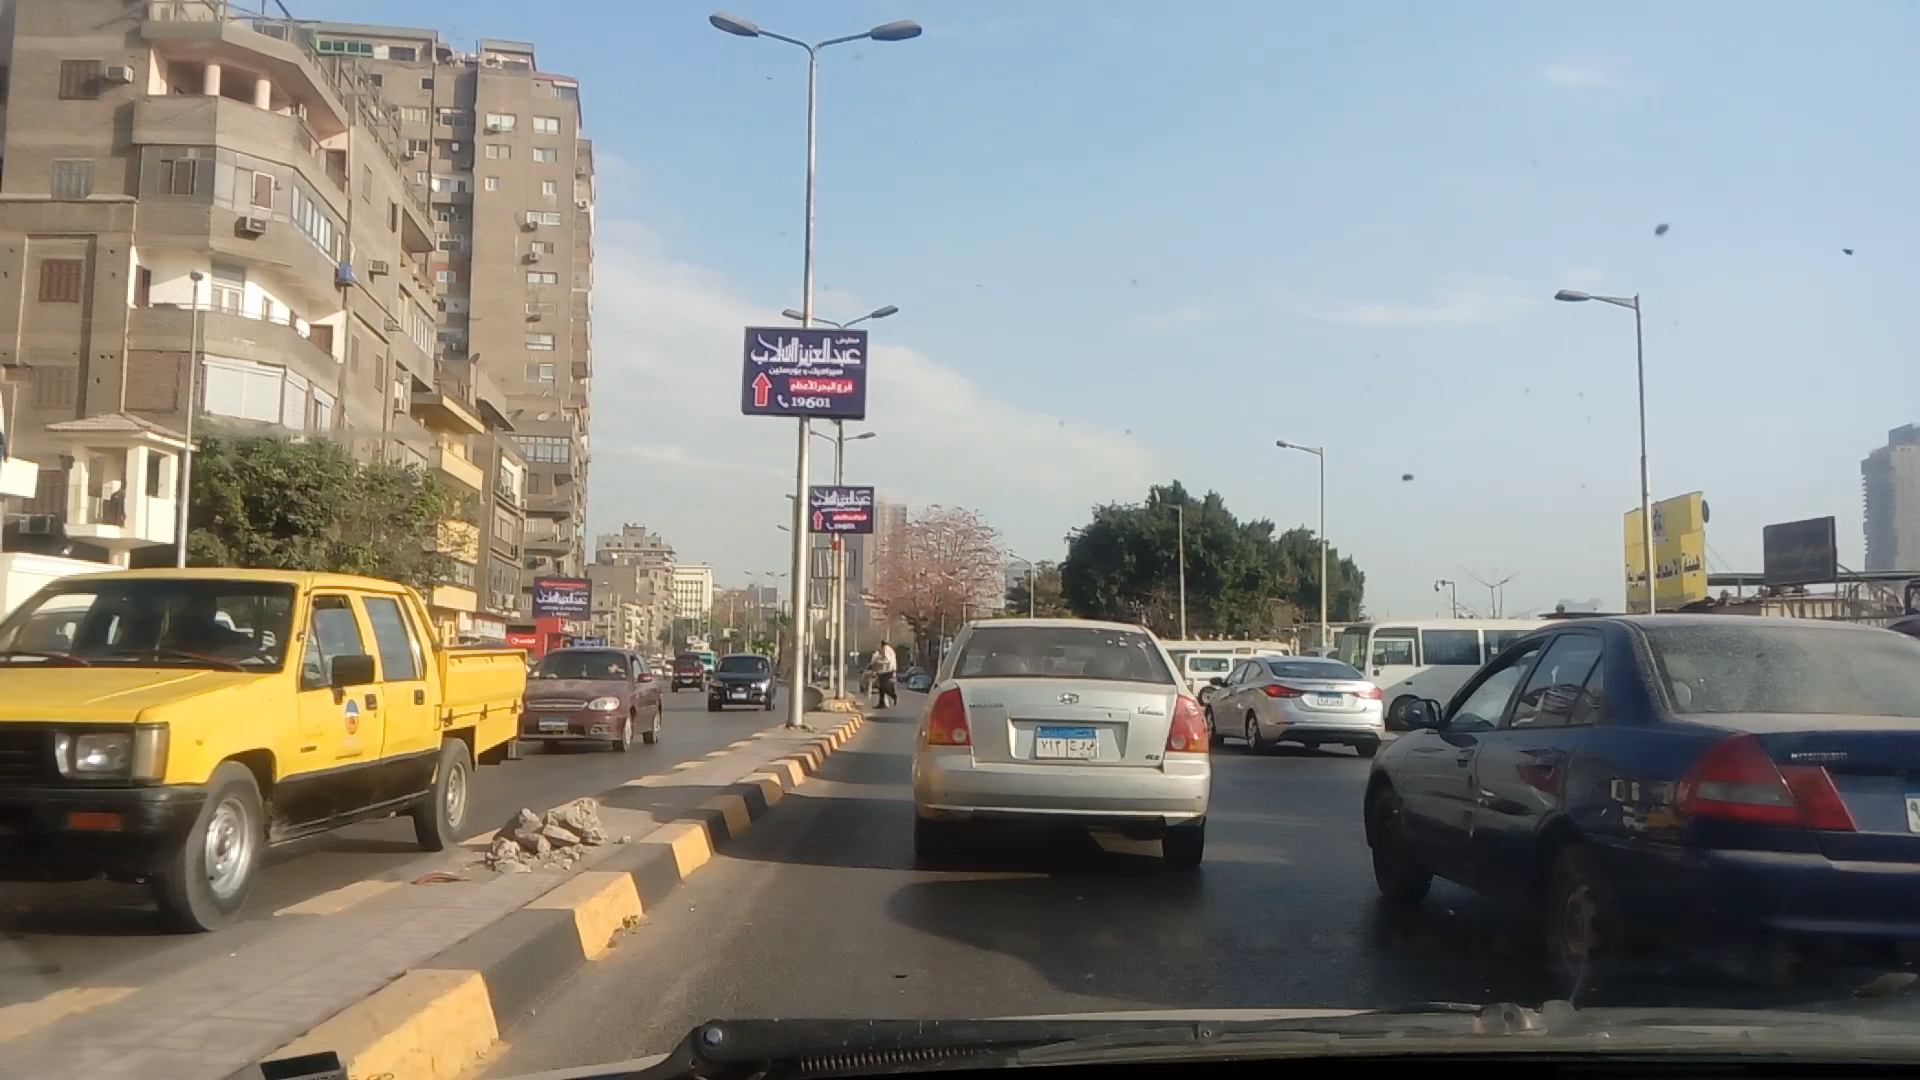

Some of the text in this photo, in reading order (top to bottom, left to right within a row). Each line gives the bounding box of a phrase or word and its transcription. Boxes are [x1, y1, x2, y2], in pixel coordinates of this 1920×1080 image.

[797, 337, 832, 368] العزيز
[829, 347, 862, 367] عبد
[816, 381, 837, 393] البحر
[836, 380, 853, 393] فرع
[790, 396, 831, 408] 19601
